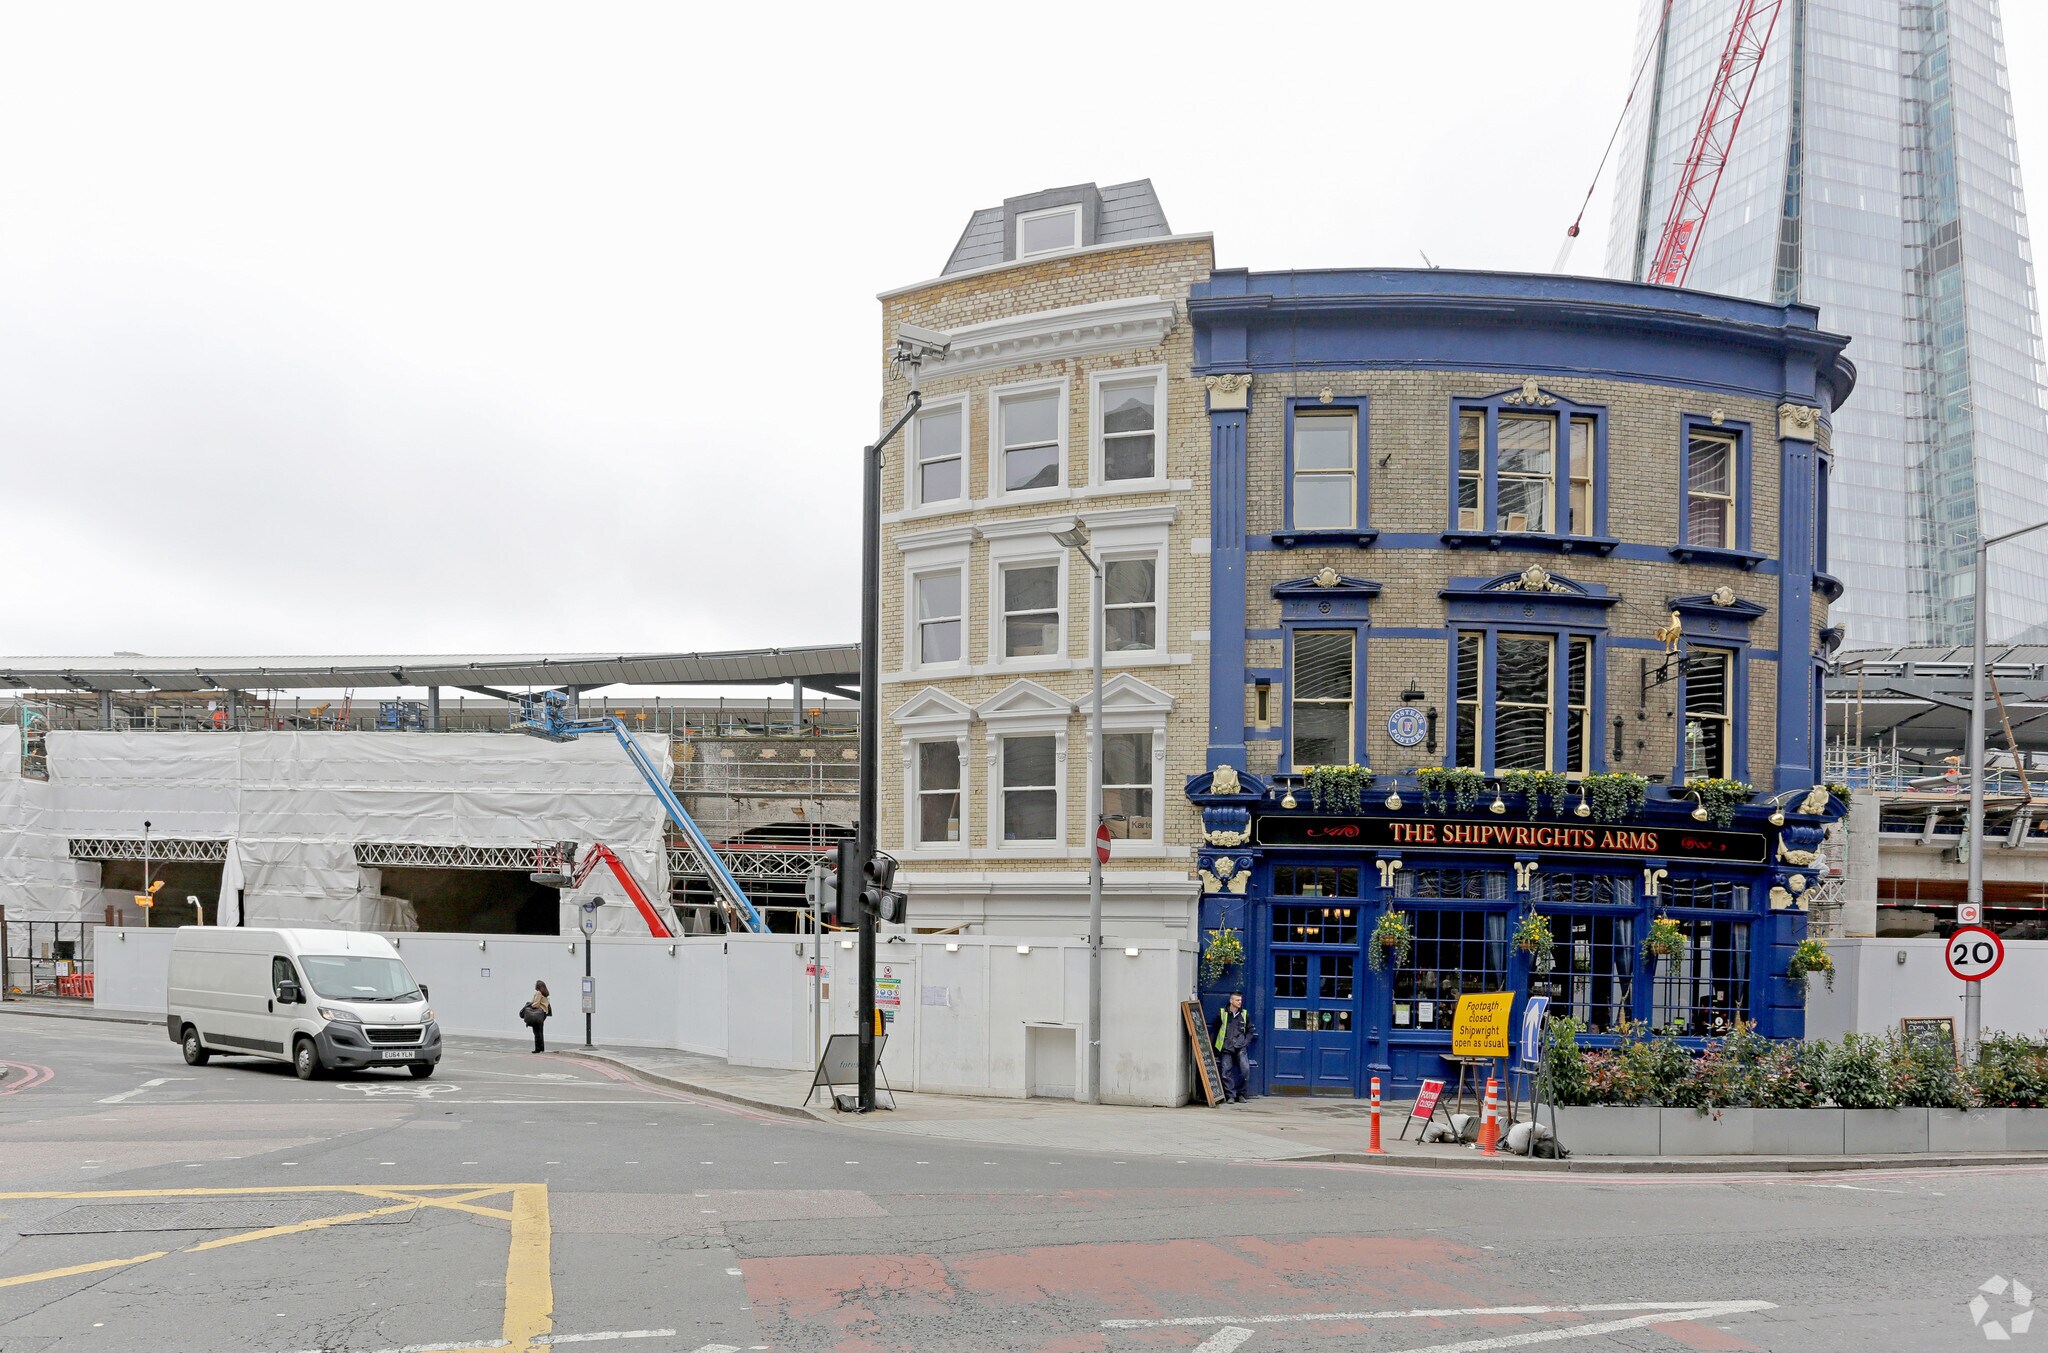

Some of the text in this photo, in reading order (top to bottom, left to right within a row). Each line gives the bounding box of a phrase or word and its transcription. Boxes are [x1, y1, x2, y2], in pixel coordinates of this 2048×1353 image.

[1389, 823, 1659, 851] THE SHIPWRIGHTS ARMS
[1953, 942, 1994, 965] 20
[1467, 1001, 1499, 1012] Footpath
[1469, 1013, 1492, 1022] closed
[1460, 1025, 1499, 1039] Shipwright
[1455, 1038, 1505, 1048] open as usual
